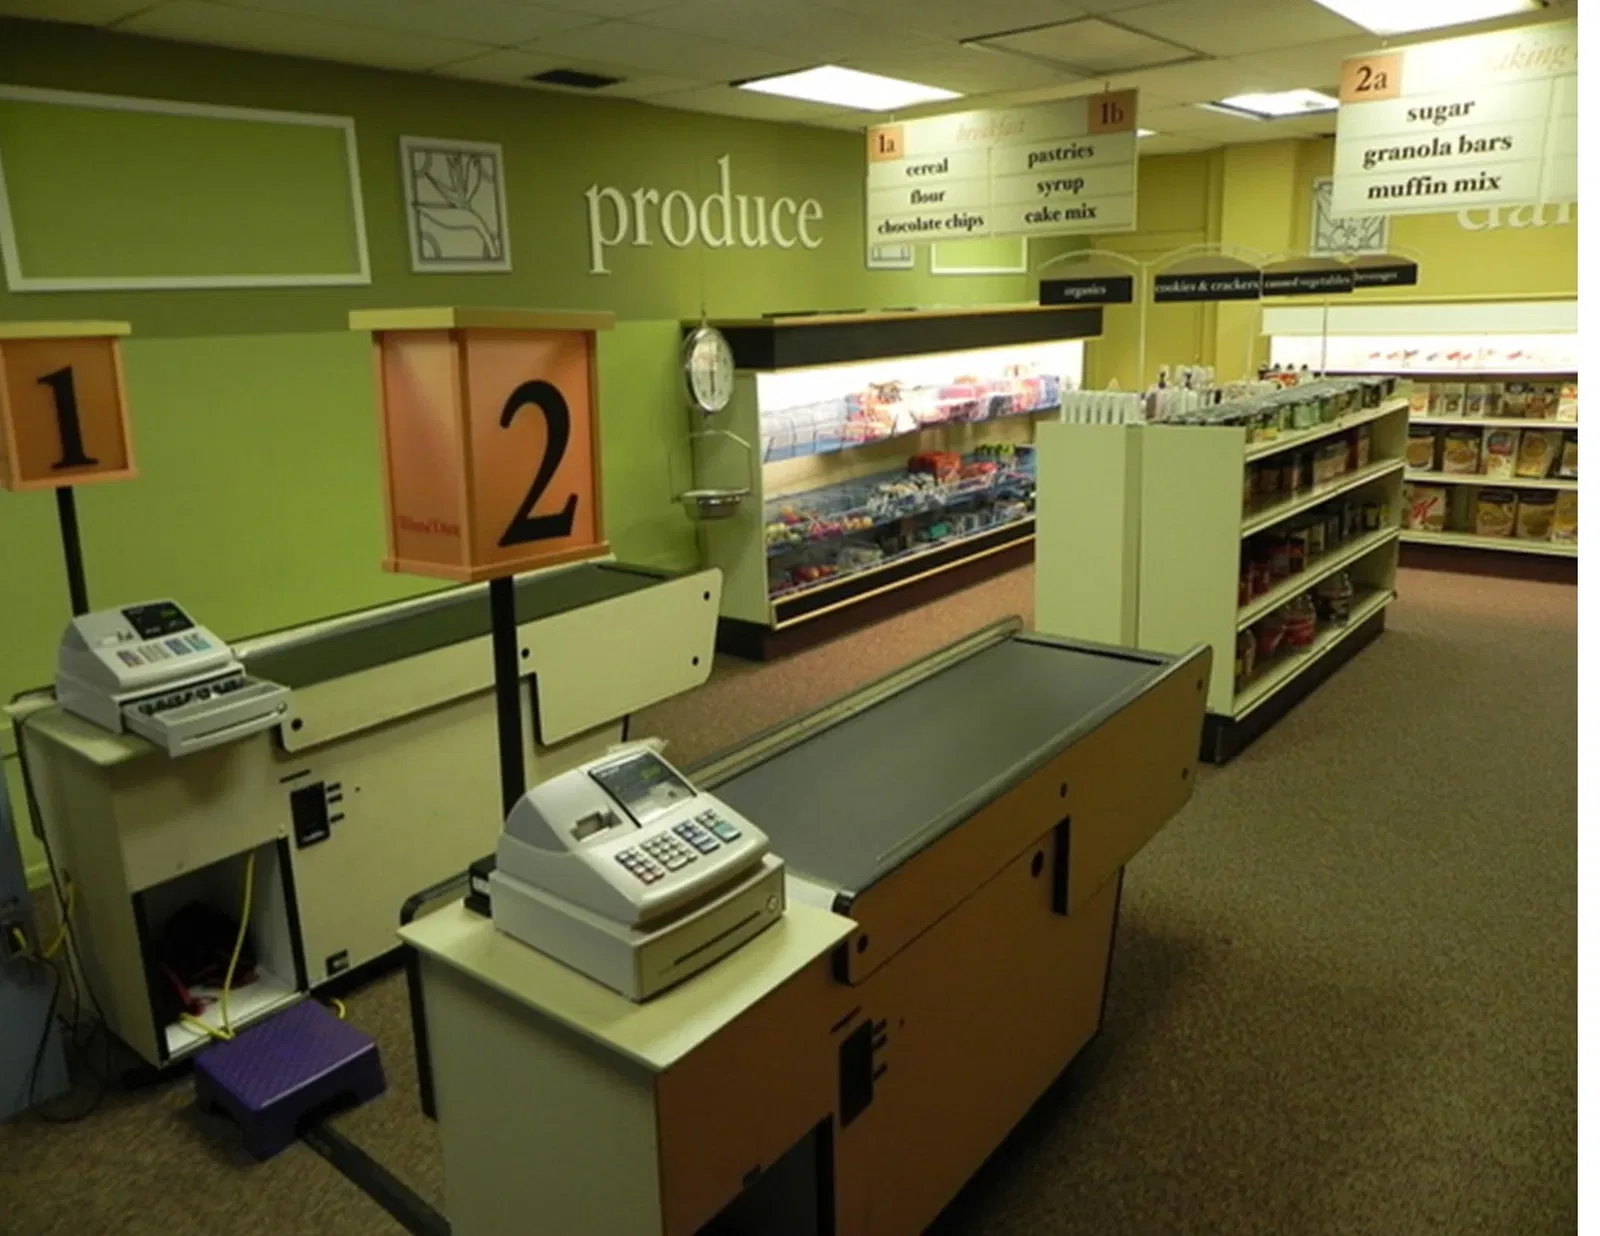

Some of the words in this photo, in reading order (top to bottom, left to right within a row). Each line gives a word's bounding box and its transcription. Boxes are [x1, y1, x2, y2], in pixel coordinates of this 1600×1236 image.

[1355, 65, 1388, 93] 2a
[1100, 100, 1124, 125] 1b
[1406, 100, 1476, 126] sugar
[878, 134, 895, 154] 1a
[1028, 141, 1094, 168] pastries
[1362, 137, 1452, 169] granola
[1458, 133, 1513, 155] bars
[906, 158, 949, 177] cereal
[910, 188, 945, 205] flour
[1037, 174, 1085, 198] syrup
[1367, 176, 1448, 200] muffin
[1453, 171, 1502, 194] mix
[584, 153, 824, 275] produce
[878, 214, 942, 235] chocolate
[945, 212, 985, 232] chips
[1025, 206, 1062, 223] cake
[1065, 202, 1097, 221] mix
[1063, 283, 1107, 300] organics
[1155, 280, 1196, 293] cookies
[1198, 280, 1209, 292] &
[1210, 276, 1260, 291] crackers
[37, 364, 99, 470] 1
[497, 378, 579, 548] 2
